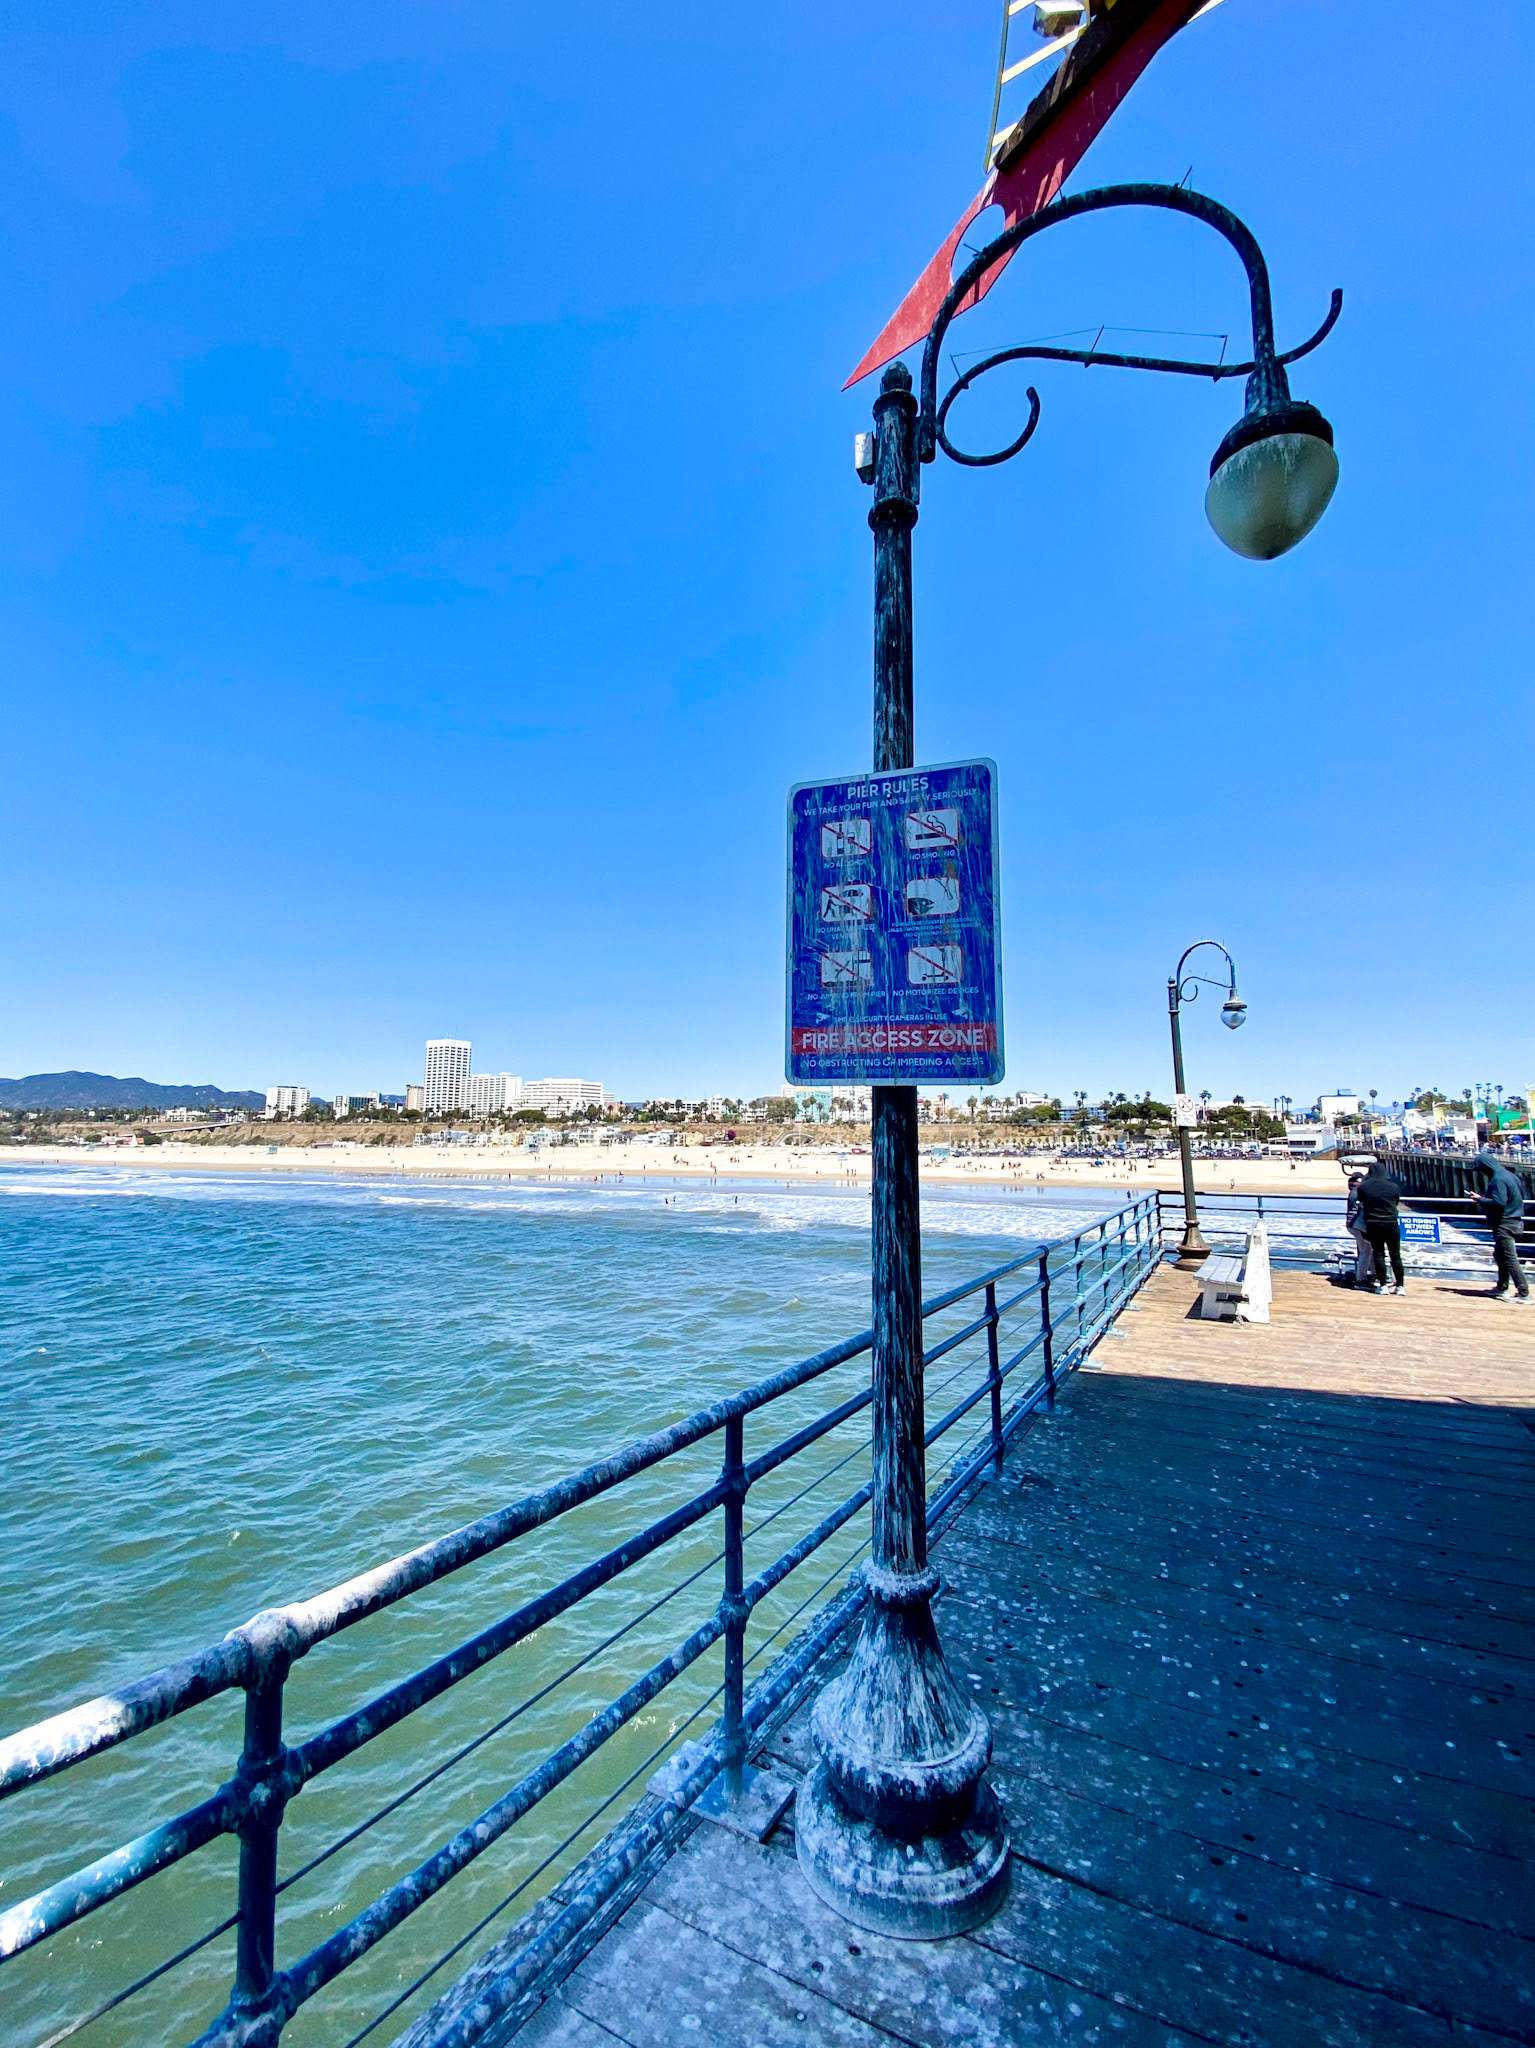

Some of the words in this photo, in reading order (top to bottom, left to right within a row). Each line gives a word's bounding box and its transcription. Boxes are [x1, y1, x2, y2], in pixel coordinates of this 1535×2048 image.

[848, 784, 878, 800] PIER
[883, 777, 929, 794] RULES
[804, 808, 816, 816] WE
[819, 806, 837, 815] TAKE
[839, 803, 860, 812] YOUR
[862, 800, 878, 809] FUN
[880, 798, 898, 807] AND
[900, 793, 931, 805] SAFEY
[932, 788, 977, 800] SERIOUSLY
[921, 849, 956, 859] SMONG
[871, 990, 886, 998] PIER
[893, 989, 904, 997] NO
[905, 987, 946, 996] MOTORIZED
[802, 1032, 838, 1049] FIRE
[844, 1030, 922, 1048] ACCESS
[928, 1028, 984, 1047] ZONE
[818, 1058, 881, 1067] OBSTRUCTING
[882, 1058, 896, 1066] OR
[898, 1057, 944, 1066] IMPEDING
